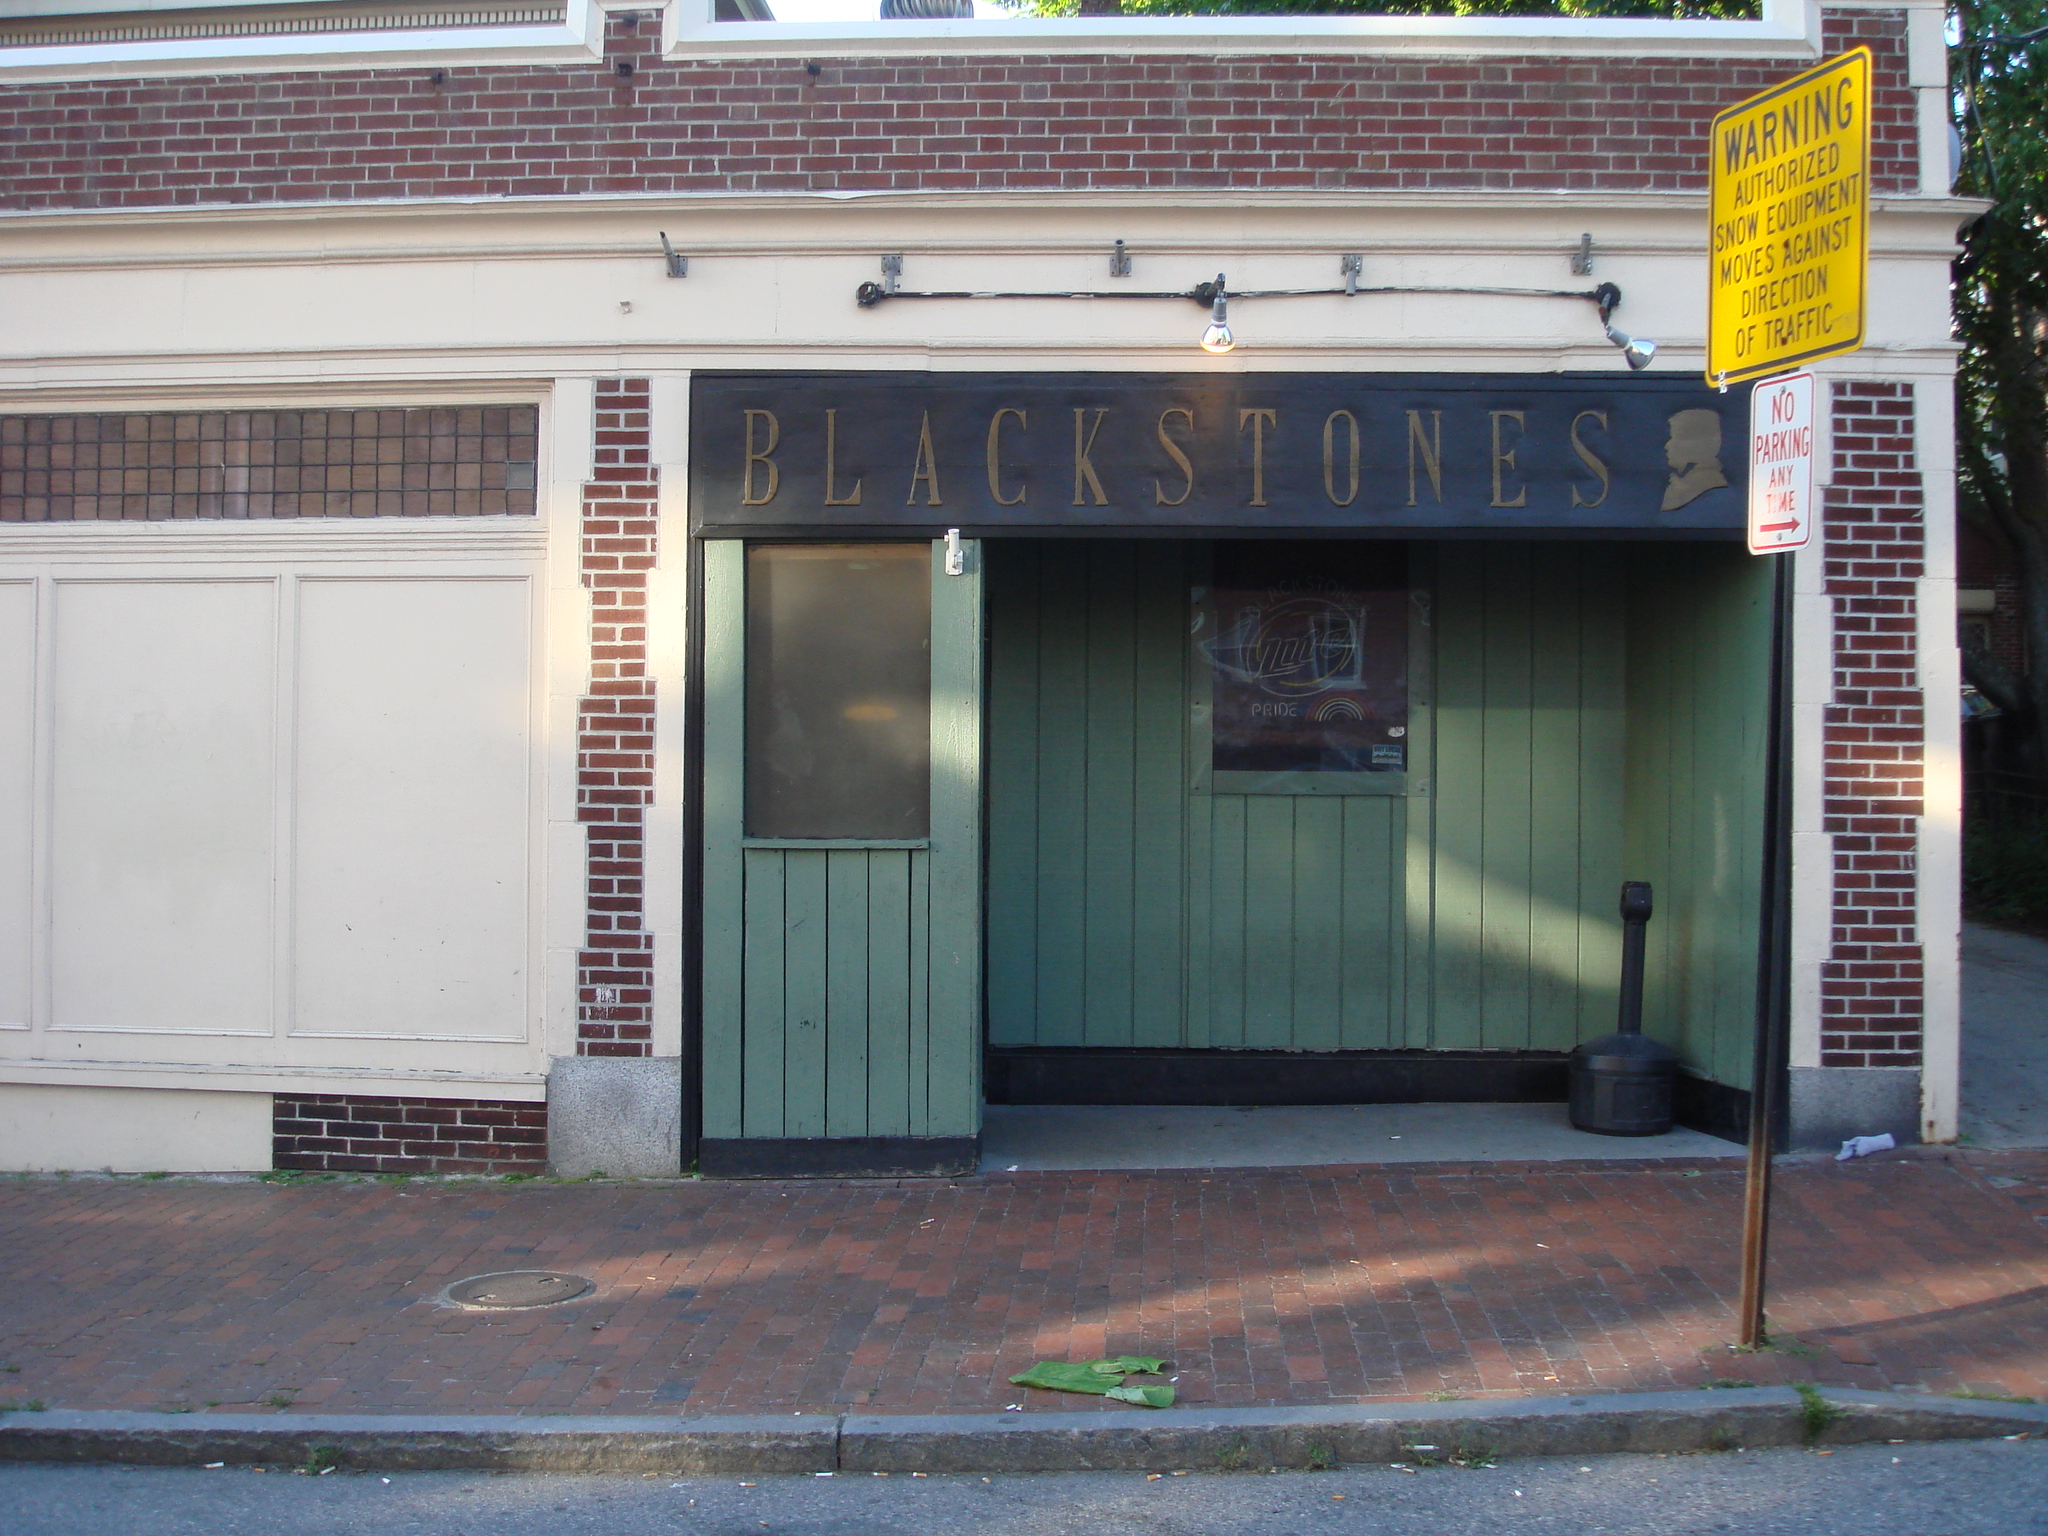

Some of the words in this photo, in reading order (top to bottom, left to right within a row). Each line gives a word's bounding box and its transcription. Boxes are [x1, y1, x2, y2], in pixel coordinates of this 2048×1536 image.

[1725, 77, 1853, 175] WARNING
[1733, 141, 1840, 210] AUTHORIZED
[1716, 210, 1758, 253] SNOW
[1767, 173, 1859, 236] EQUIPMENT
[1721, 245, 1774, 288] MOVES
[1782, 216, 1852, 265] AGAINST
[1741, 265, 1828, 319] DIRECTION
[1736, 325, 1755, 359] OF
[1765, 302, 1833, 349] TRAFFIC
[1771, 391, 1795, 425] NO
[741, 406, 1611, 509] BLACKSTONES
[1756, 426, 1810, 465] PARKING
[1766, 490, 1795, 515] TIME
[1769, 465, 1794, 488] ANY
[1251, 702, 1298, 717] PRIDE
